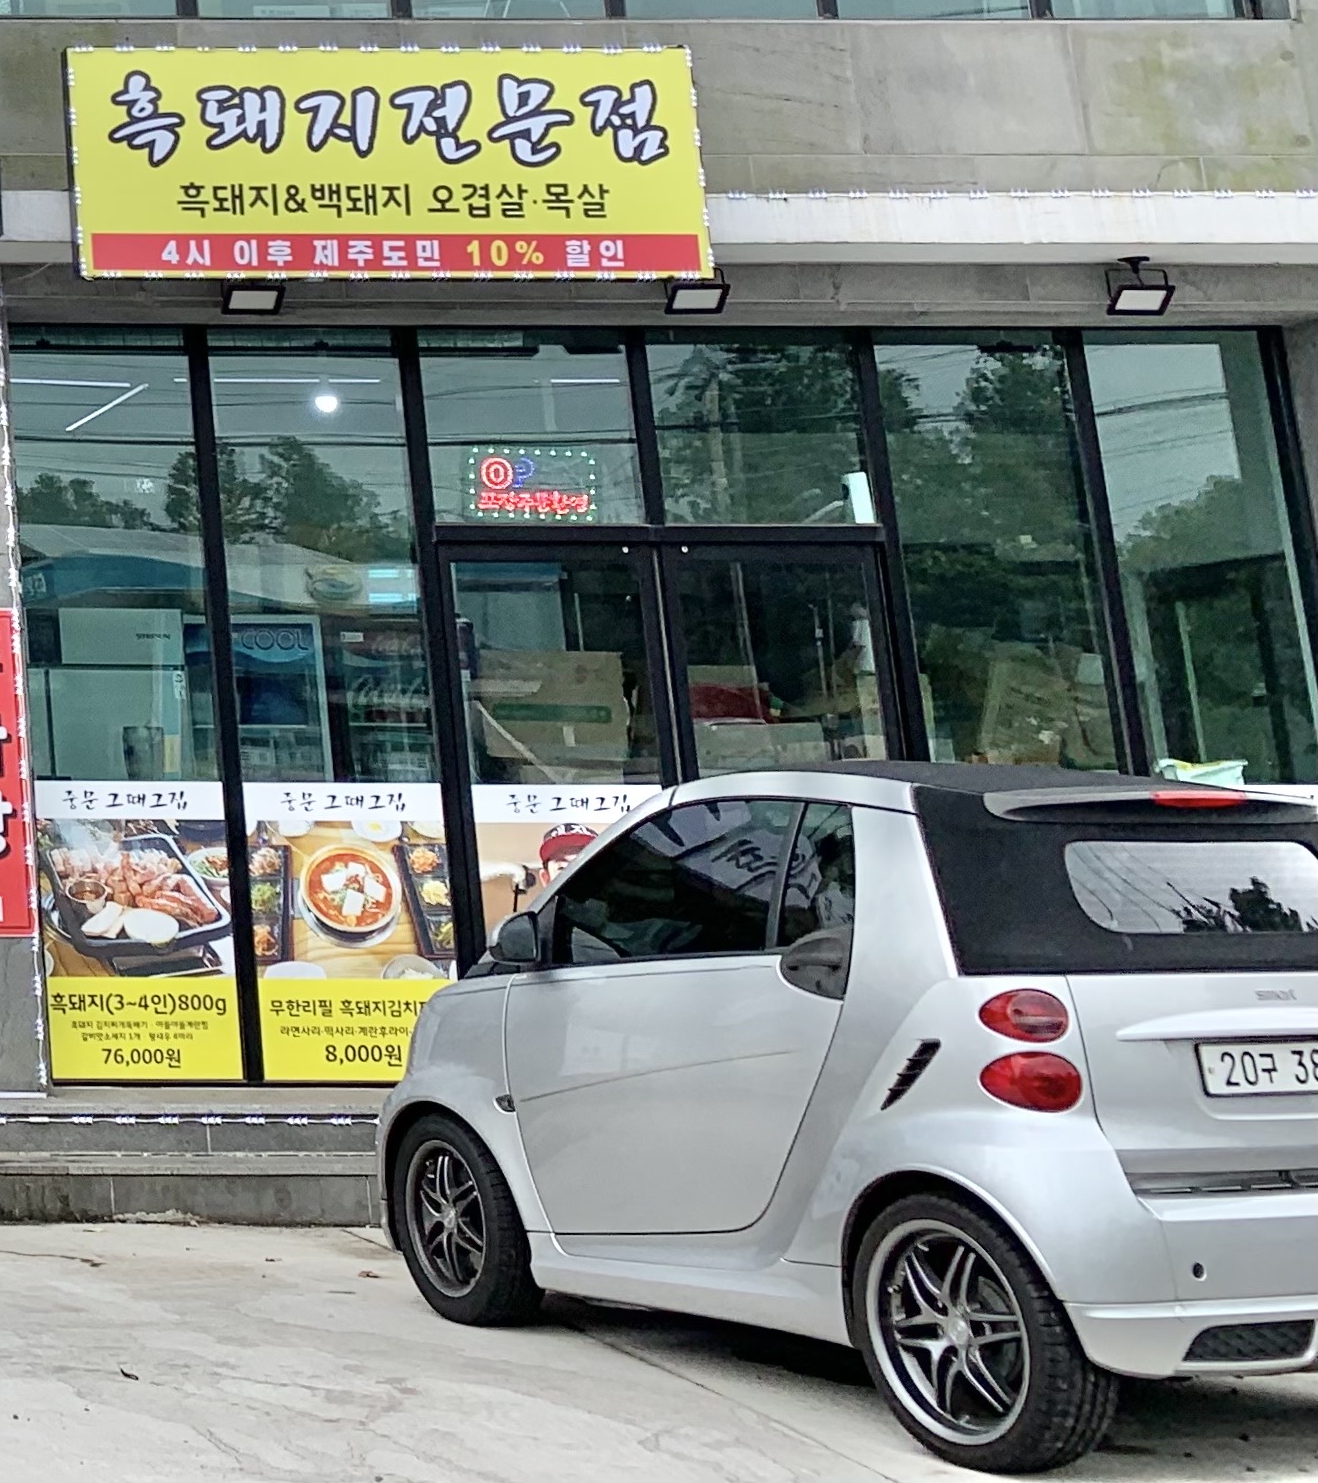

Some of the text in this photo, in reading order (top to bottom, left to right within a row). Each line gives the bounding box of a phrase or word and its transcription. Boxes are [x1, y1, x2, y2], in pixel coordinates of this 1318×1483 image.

[109, 72, 669, 166] 흑돼지전문점
[177, 183, 610, 219] 흑돼지&백돼지 오겹살·목살
[162, 238, 625, 269] 4시 이후 제주도민 10% 할인
[241, 628, 309, 652] COOL
[62, 789, 188, 811] 중문 그때그집
[281, 790, 406, 812] 중문 그때그집
[507, 794, 632, 814] 중문 그때그집
[50, 993, 227, 1015] 흑돼지(3~4인)800g
[270, 999, 333, 1017] 무한리필
[101, 1048, 181, 1068] 76,000원
[325, 1045, 403, 1067] 8,000원
[1220, 1051, 1278, 1086] 20구
